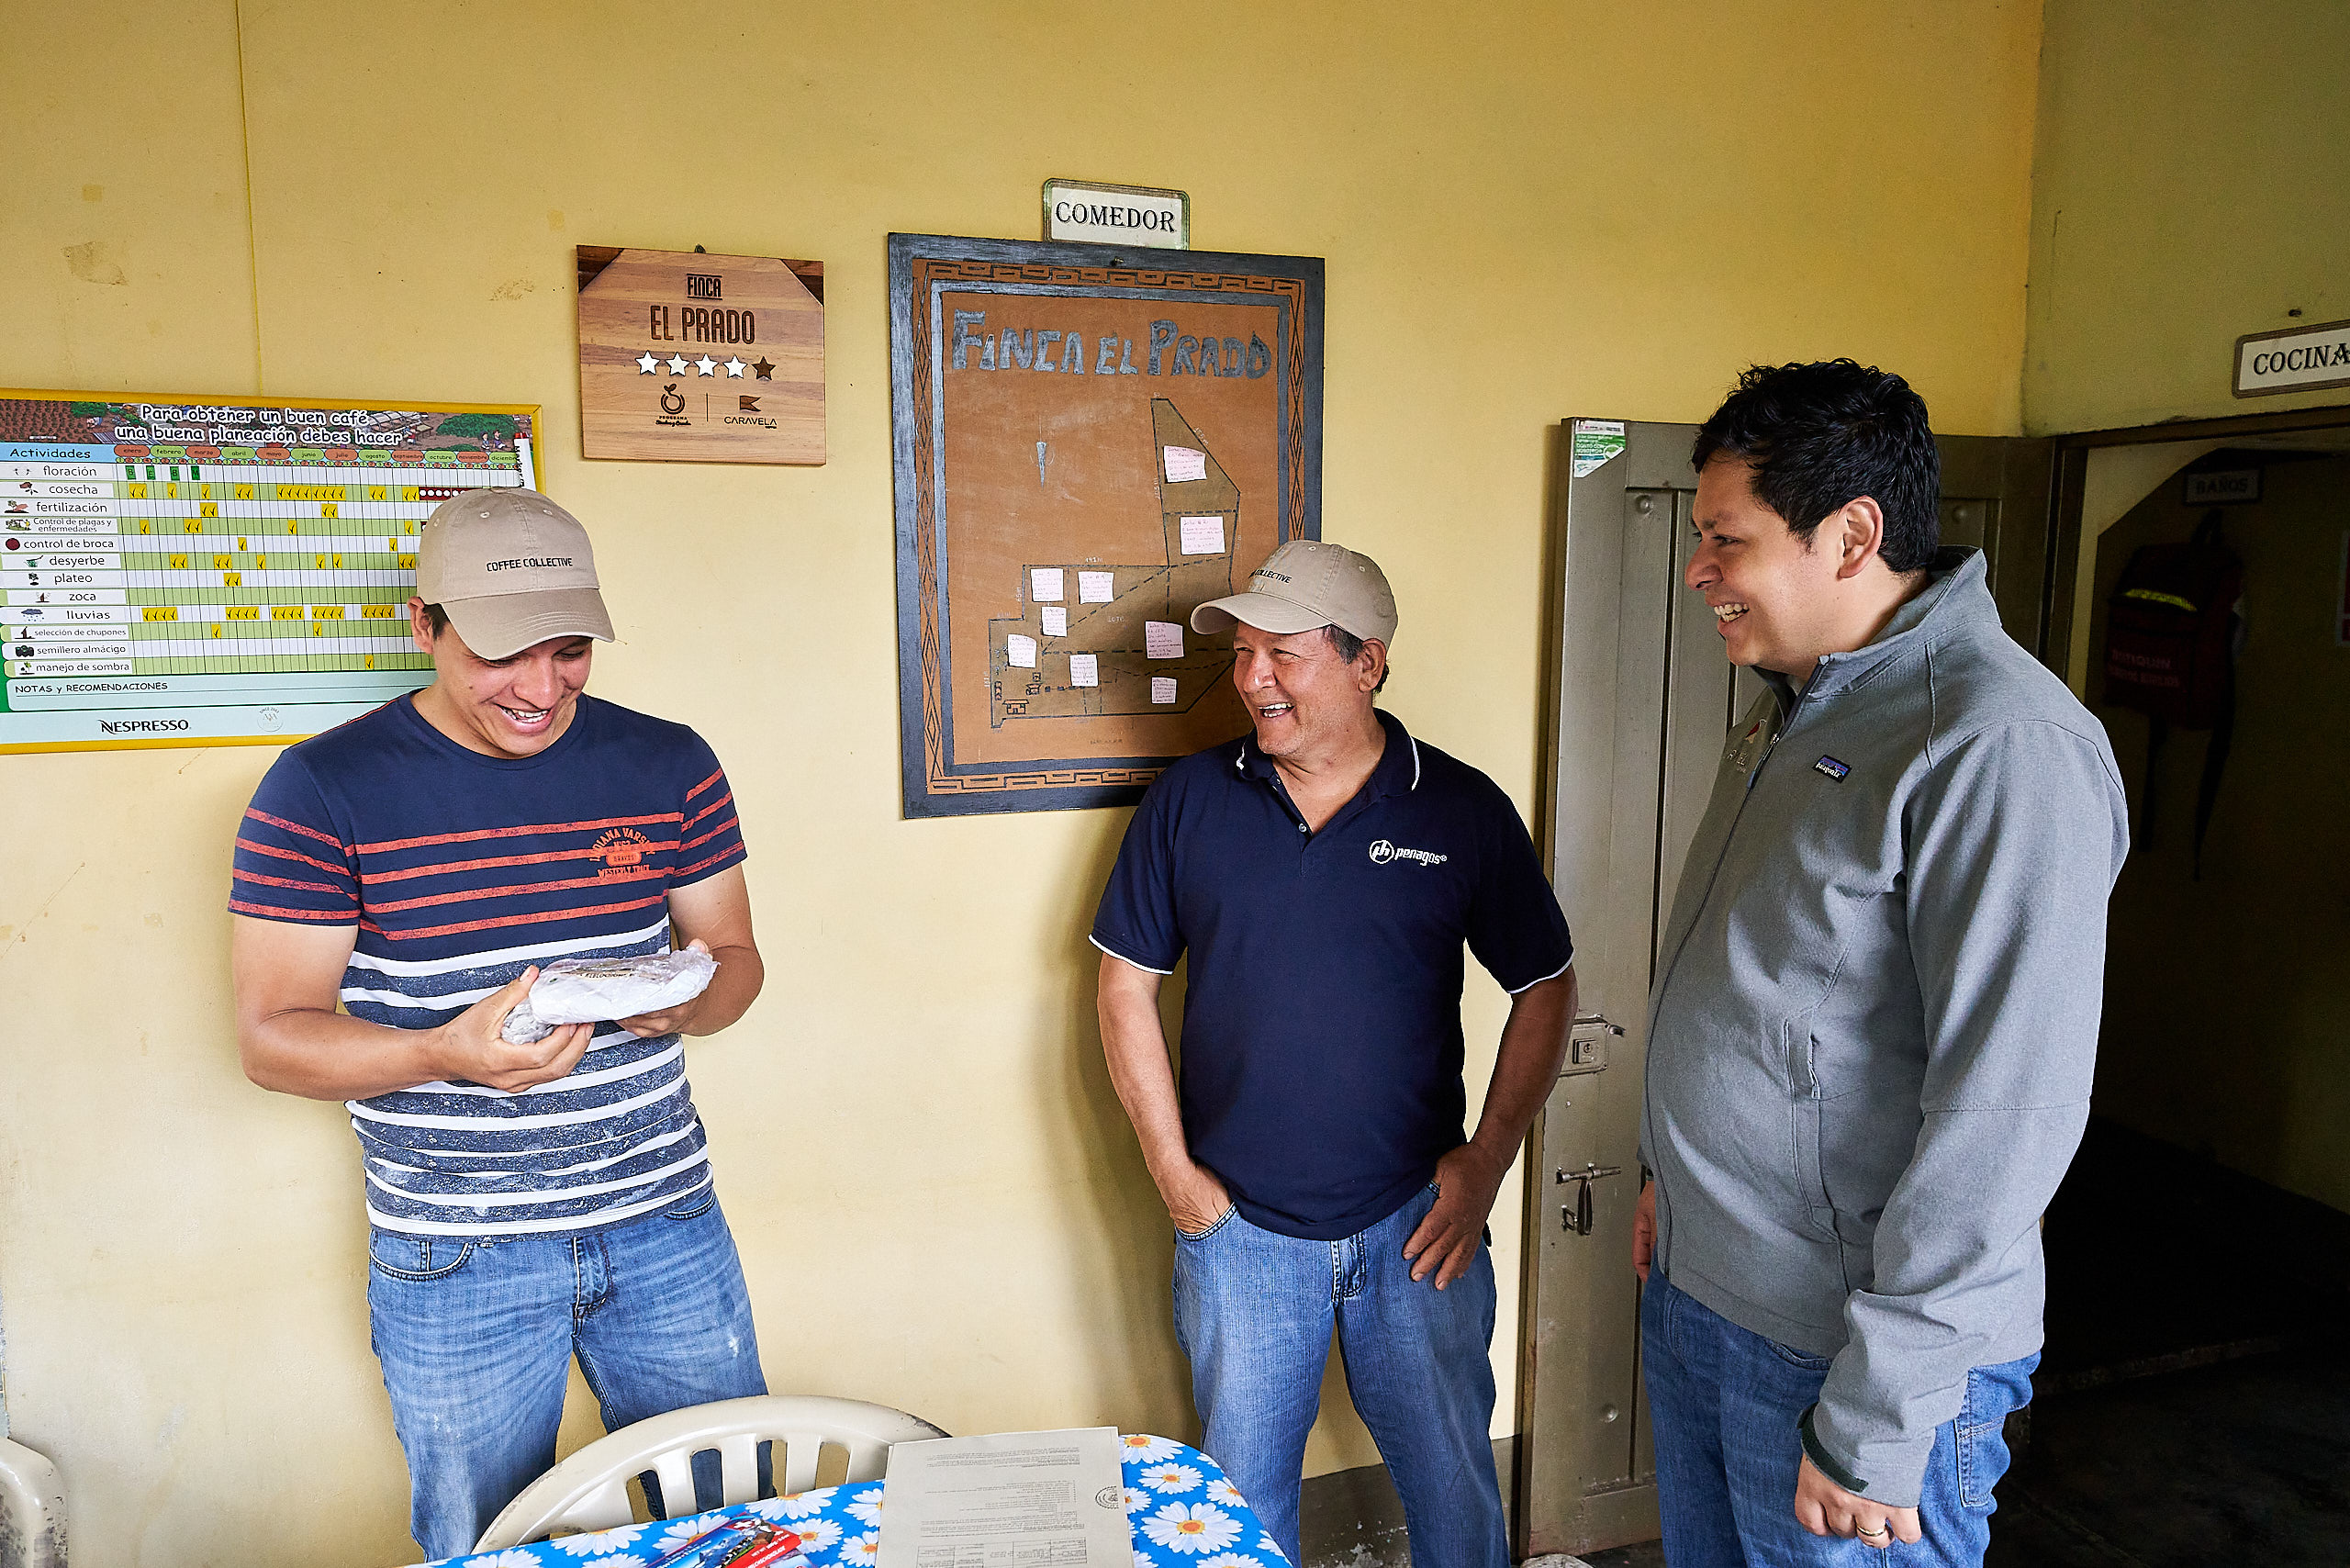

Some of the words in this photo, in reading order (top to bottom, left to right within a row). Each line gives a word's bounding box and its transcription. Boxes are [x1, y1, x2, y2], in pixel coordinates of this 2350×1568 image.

[1056, 201, 1177, 233] COMEDOR
[687, 275, 722, 298] FINCA
[650, 305, 675, 342] EL
[681, 307, 755, 345] PRADO
[952, 308, 1085, 375] FINCA
[1094, 335, 1139, 375] EL
[2253, 342, 2350, 376] COCINA
[142, 406, 181, 420] Para
[188, 407, 253, 421] obtener
[262, 410, 280, 422] un
[286, 409, 325, 423] buen
[332, 411, 366, 424] café
[723, 416, 778, 426] CARAVELA
[117, 427, 146, 438] una
[153, 425, 203, 440] buena
[211, 426, 295, 444] planeación
[302, 429, 350, 442] debes
[356, 430, 401, 443] hacer
[9, 448, 91, 459] Actividades
[43, 465, 97, 476] floración
[49, 484, 98, 495] cosecha
[36, 501, 107, 512] fertilización
[33, 517, 64, 525] Control
[78, 518, 105, 527] plagas
[24, 539, 63, 549] control
[66, 539, 80, 548] de
[83, 538, 114, 548] broca
[49, 555, 105, 568] desyerbe
[487, 558, 522, 572] COFFEE
[523, 557, 574, 567] COLLECTIVE
[54, 573, 93, 585] plateo
[69, 593, 96, 601] zoca
[66, 610, 111, 620] lluvias
[34, 628, 73, 636] selección
[74, 628, 84, 636] de
[86, 628, 127, 637] chupones
[37, 645, 81, 655] semillero
[83, 644, 127, 655] almácigo
[36, 663, 74, 673] manejo
[76, 662, 90, 671] de
[92, 661, 129, 671] sombra
[15, 685, 53, 693] NOTAS
[57, 686, 62, 694] y
[66, 682, 168, 692] RECOMENDACIONES
[97, 719, 189, 735] NESPRESSO
